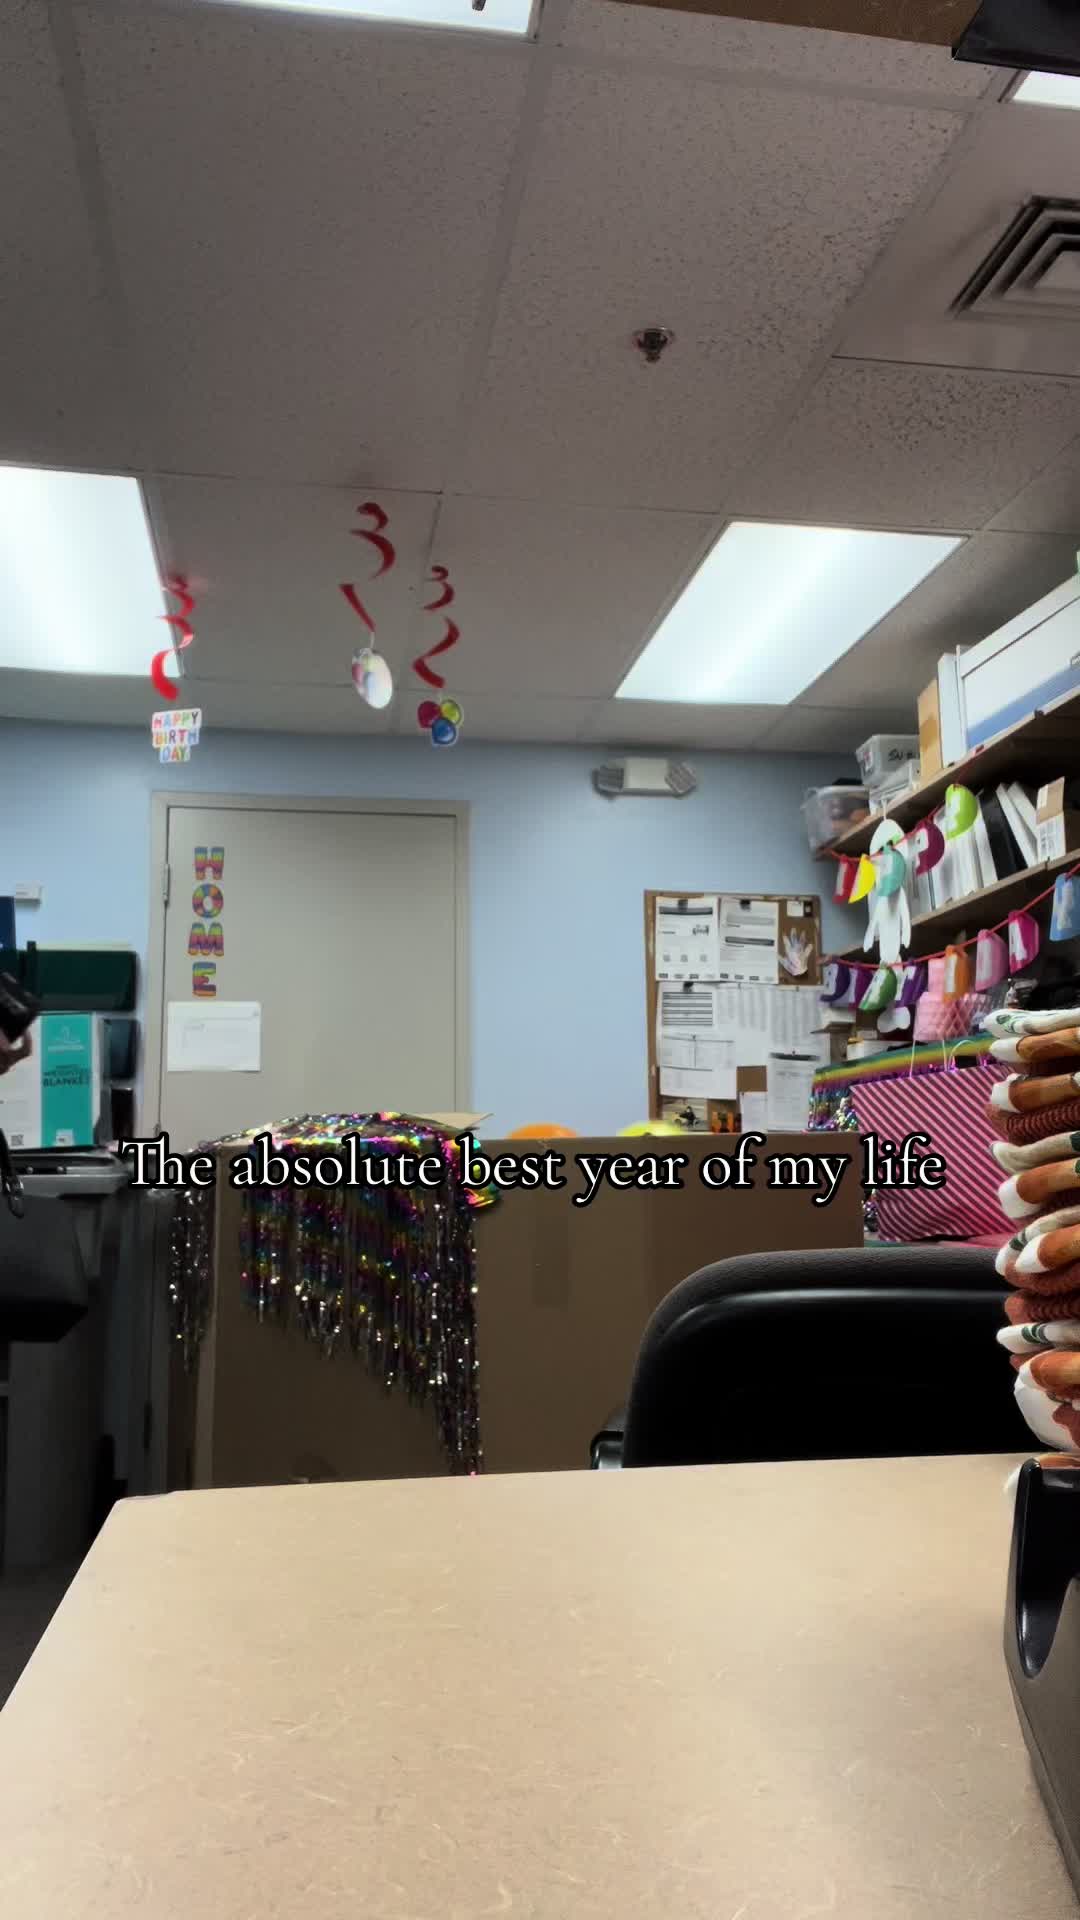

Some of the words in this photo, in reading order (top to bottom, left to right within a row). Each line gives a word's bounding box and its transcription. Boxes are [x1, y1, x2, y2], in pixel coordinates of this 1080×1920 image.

[153, 711, 200, 729] HAPPY
[161, 745, 191, 761] DAY
[188, 847, 225, 997] HOME
